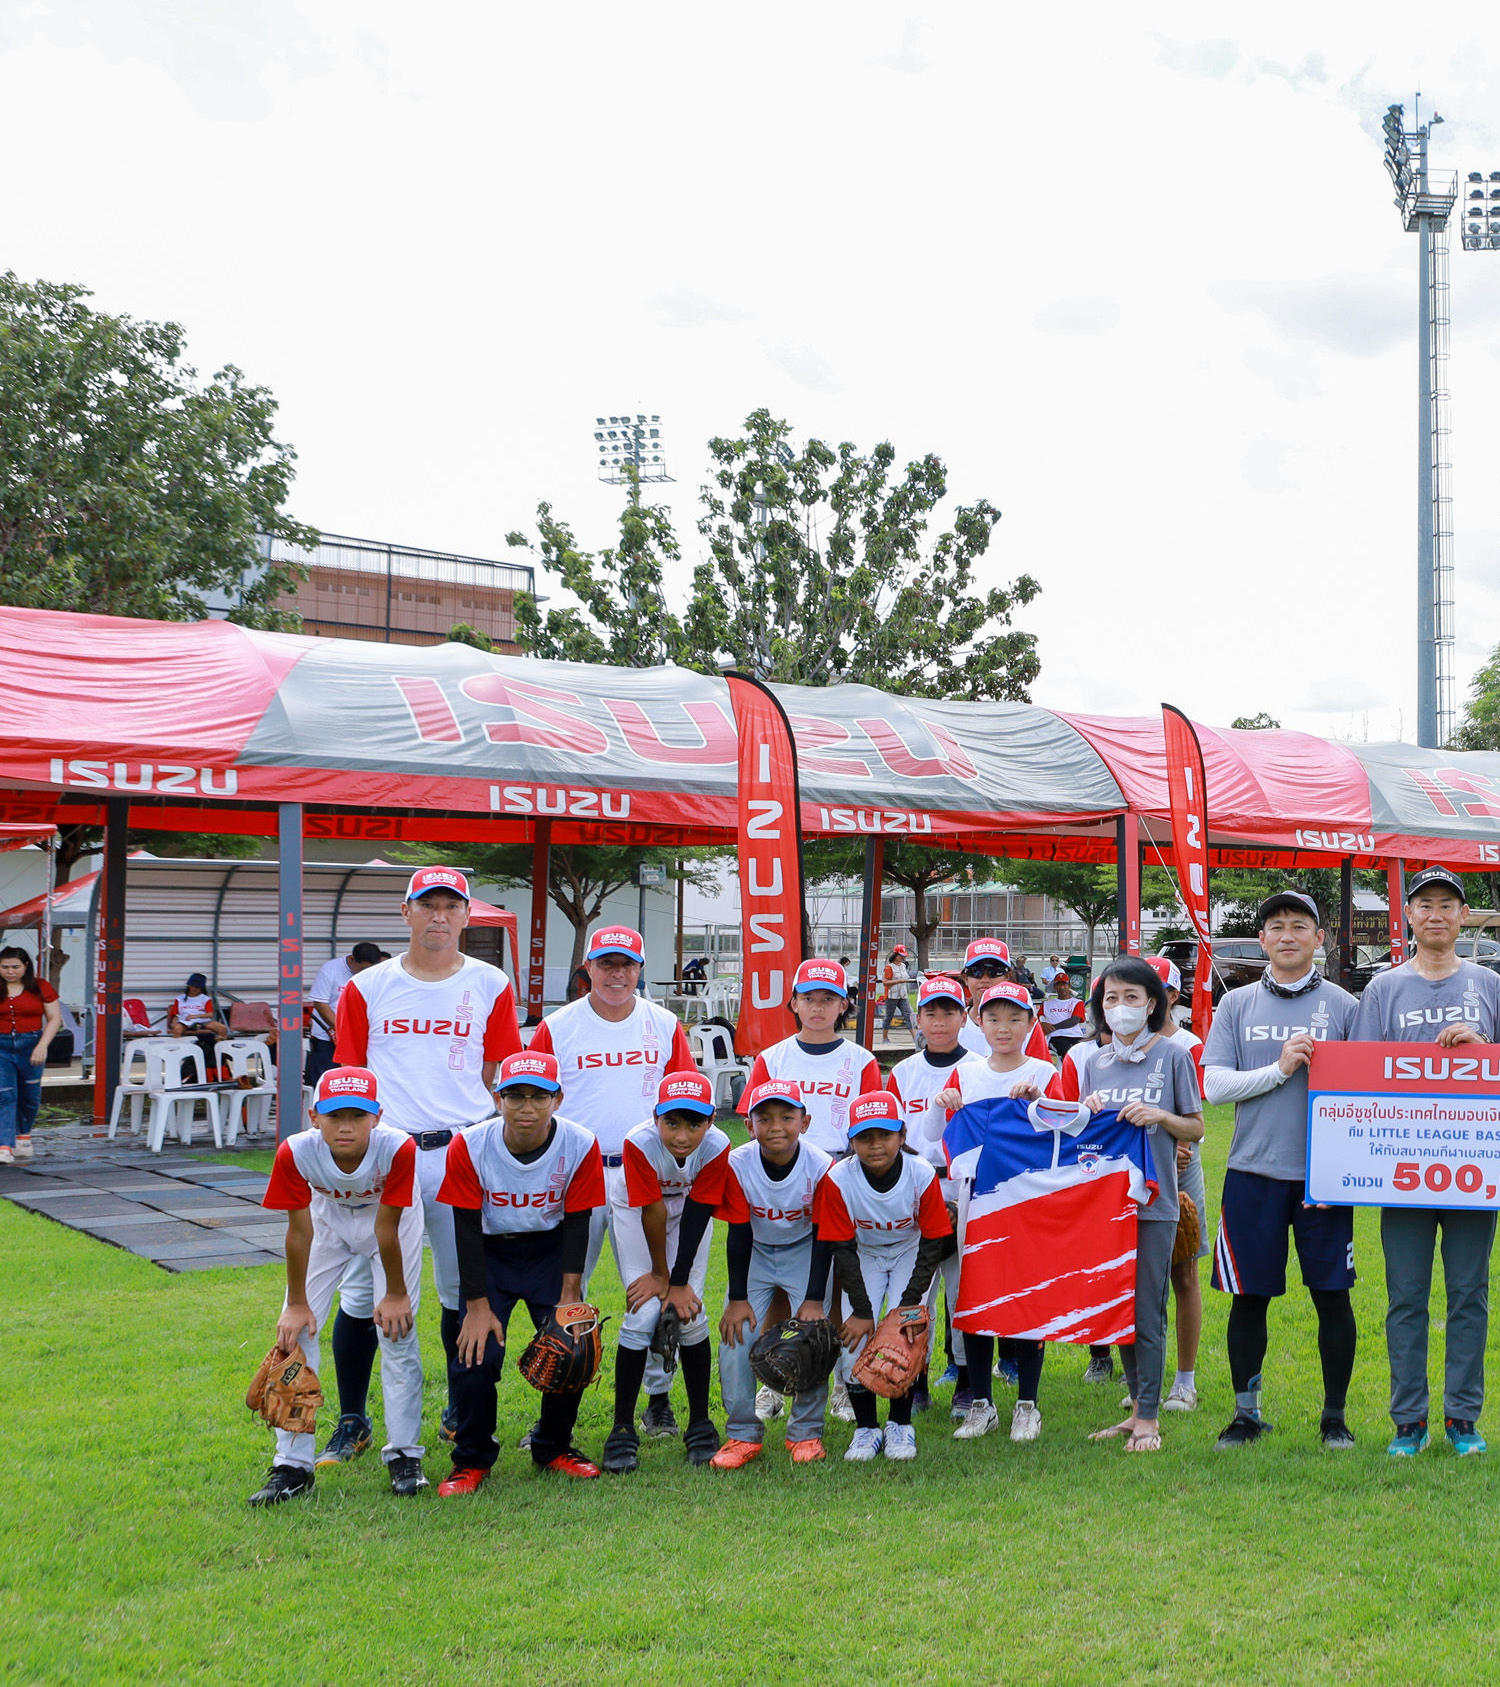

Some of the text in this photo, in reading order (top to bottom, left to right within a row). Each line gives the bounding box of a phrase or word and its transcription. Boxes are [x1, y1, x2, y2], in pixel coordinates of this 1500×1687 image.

[391, 673, 978, 779] ISUZU
[50, 758, 238, 796] ISUZU
[490, 785, 630, 818] ISUZU
[821, 808, 931, 834] ISUZU
[1296, 829, 1375, 853] ISUZU
[422, 872, 457, 881] ISUZU
[1422, 873, 1453, 882] ISUZU
[601, 933, 632, 942] ISUZU
[529, 919, 544, 1003] ISUZU
[868, 926, 878, 1000] ISUZU
[281, 912, 300, 1032] ISUZU
[807, 966, 837, 975] ISUZU
[1399, 1006, 1480, 1029] ISUZU
[384, 1019, 470, 1037] ISUZU
[510, 1058, 546, 1068] ISUZU
[578, 1050, 659, 1069] ISUZU
[328, 1077, 369, 1086] ISUZU
[668, 1082, 702, 1090] ISUZU
[758, 1082, 791, 1093] ISUZU
[1093, 1087, 1162, 1103] SUZU
[856, 1102, 888, 1112] ISUZU
[1369, 1128, 1410, 1139] LITTLE
[1417, 1129, 1470, 1140] LEAGUE
[1342, 1173, 1383, 1188] จำนวน
[485, 1190, 564, 1208] ISUZU
